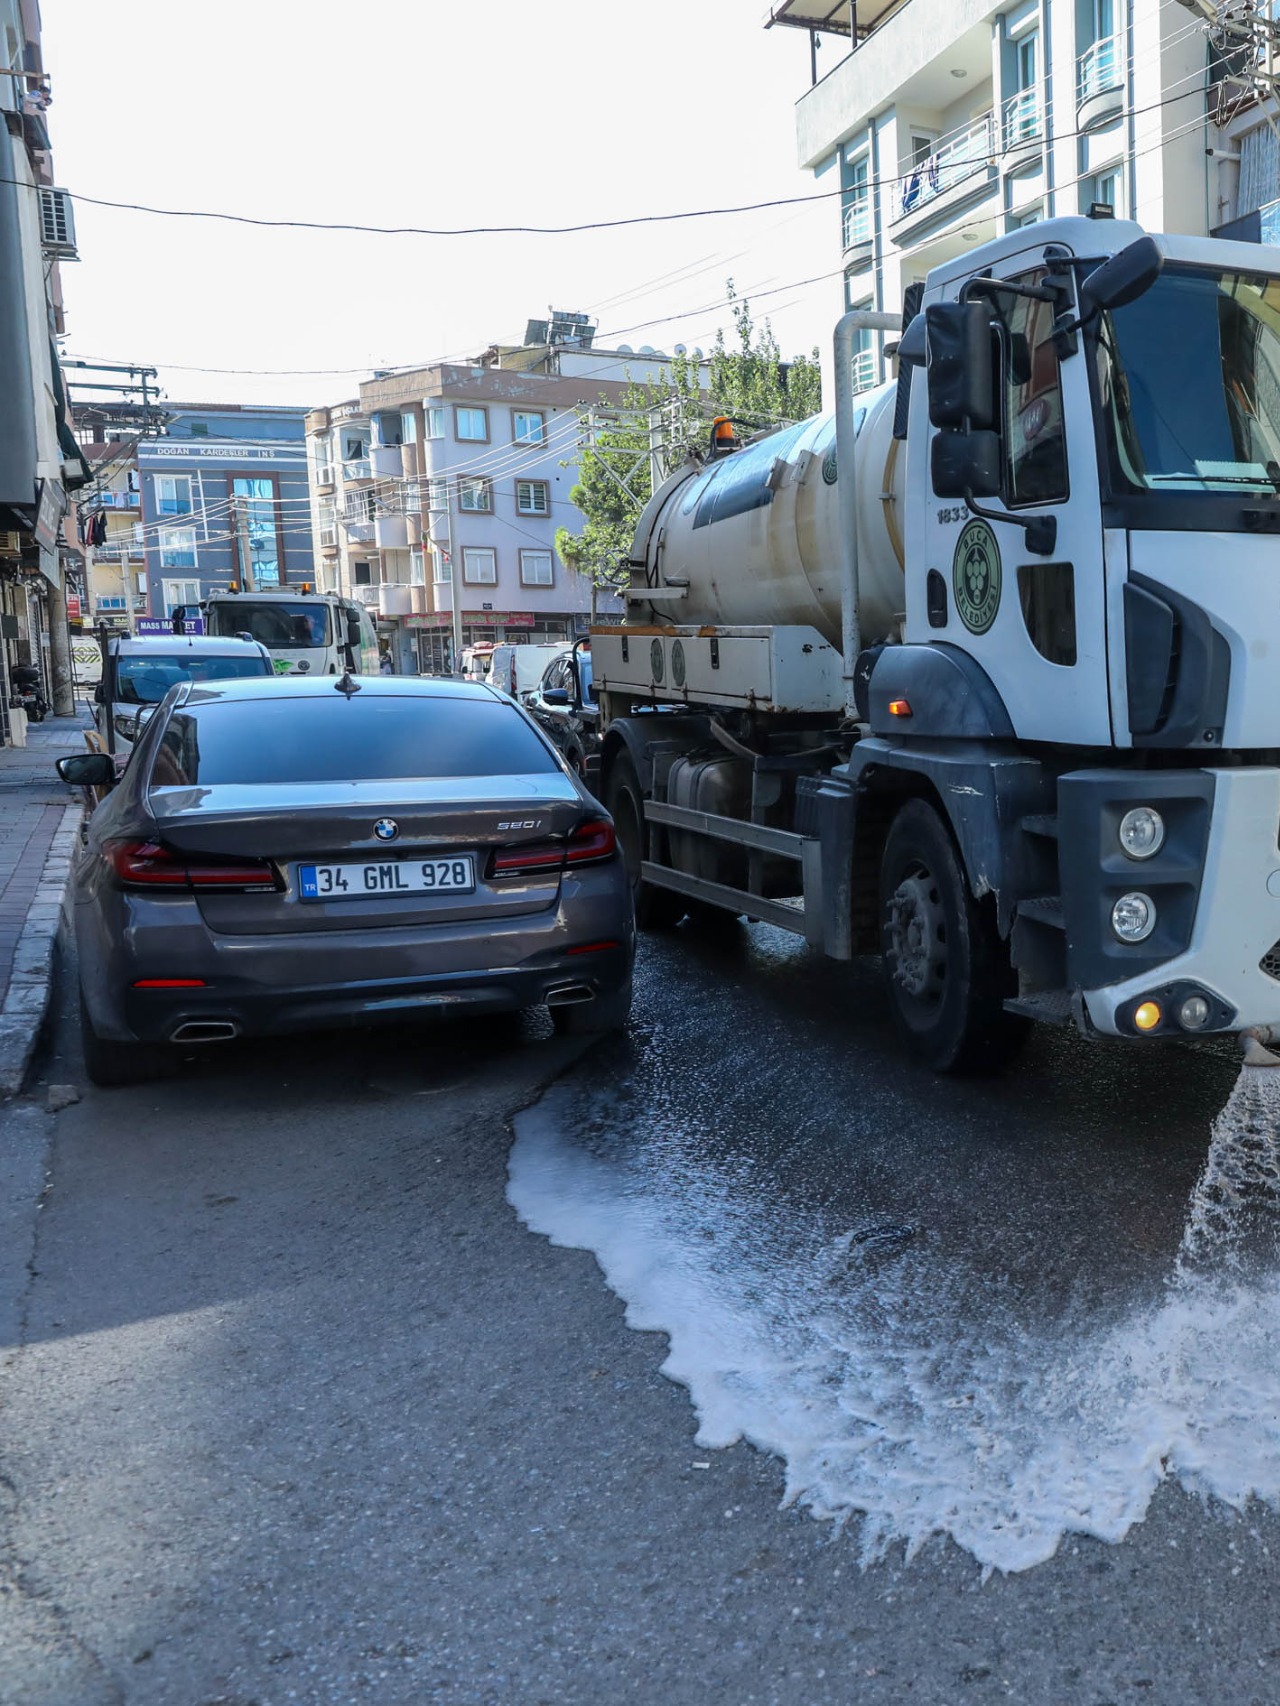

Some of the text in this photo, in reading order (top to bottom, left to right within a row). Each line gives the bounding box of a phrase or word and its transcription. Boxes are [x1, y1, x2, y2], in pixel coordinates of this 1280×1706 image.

[937, 506, 970, 525] 1833
[963, 530, 989, 550] BUCA
[957, 584, 997, 624] BELEDİYESİ
[140, 621, 160, 630] MASS
[161, 620, 196, 630] MAET
[304, 861, 467, 893] TR 34 GML 928
